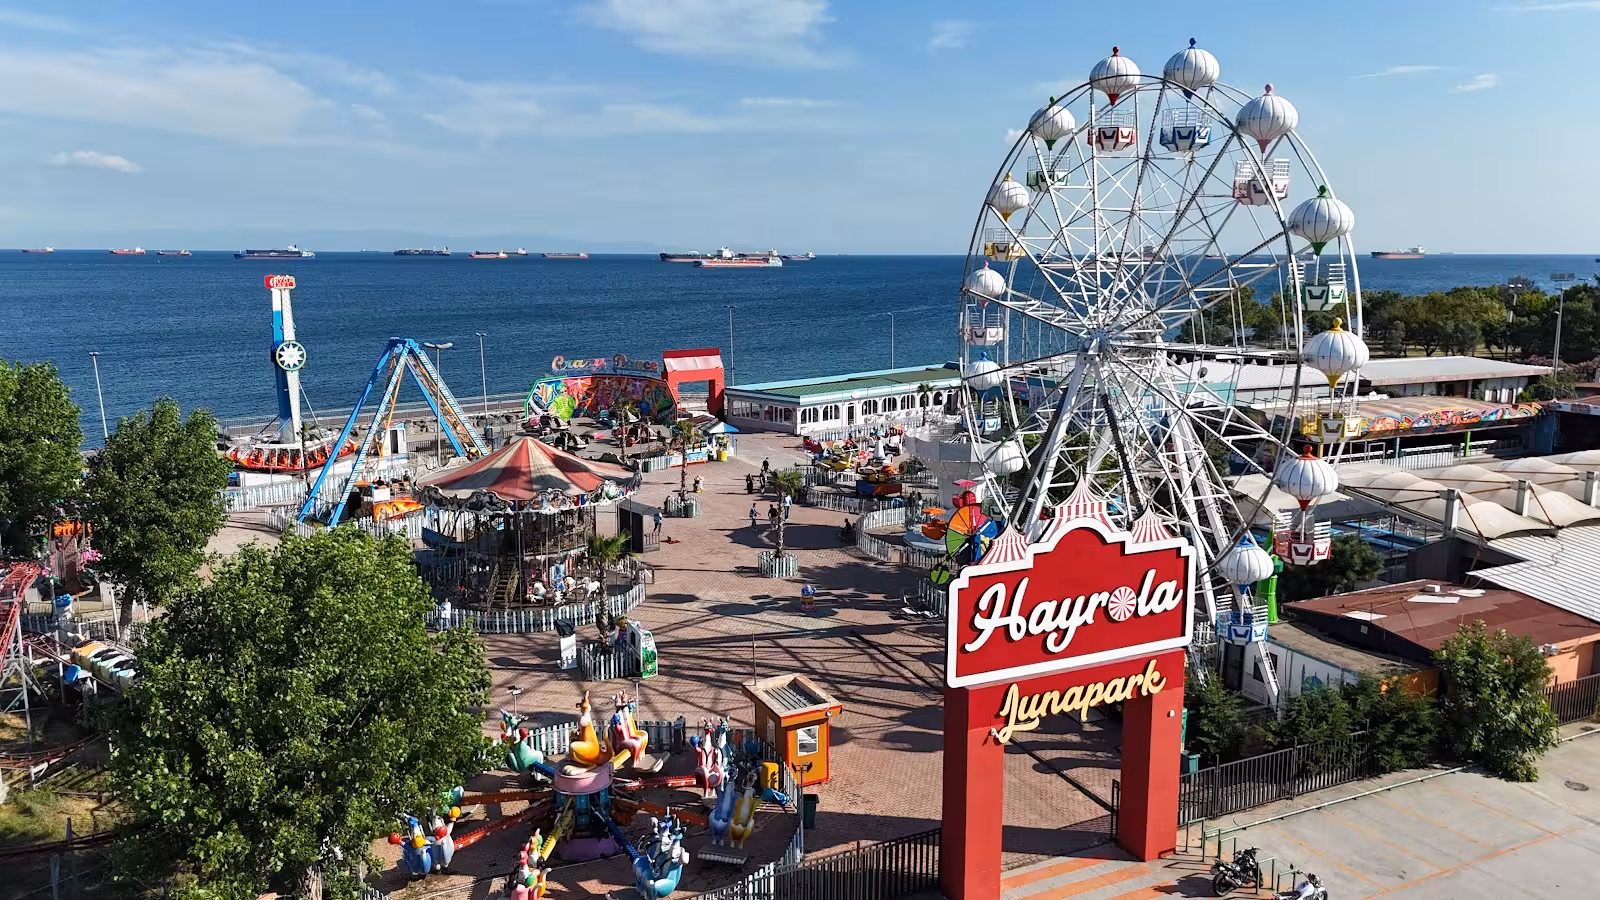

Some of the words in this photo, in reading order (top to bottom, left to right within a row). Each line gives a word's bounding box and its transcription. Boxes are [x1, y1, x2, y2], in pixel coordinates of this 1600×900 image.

[552, 356, 606, 373] Crazy
[965, 568, 1184, 653] Hayrola
[998, 659, 1167, 744] Lunapark
